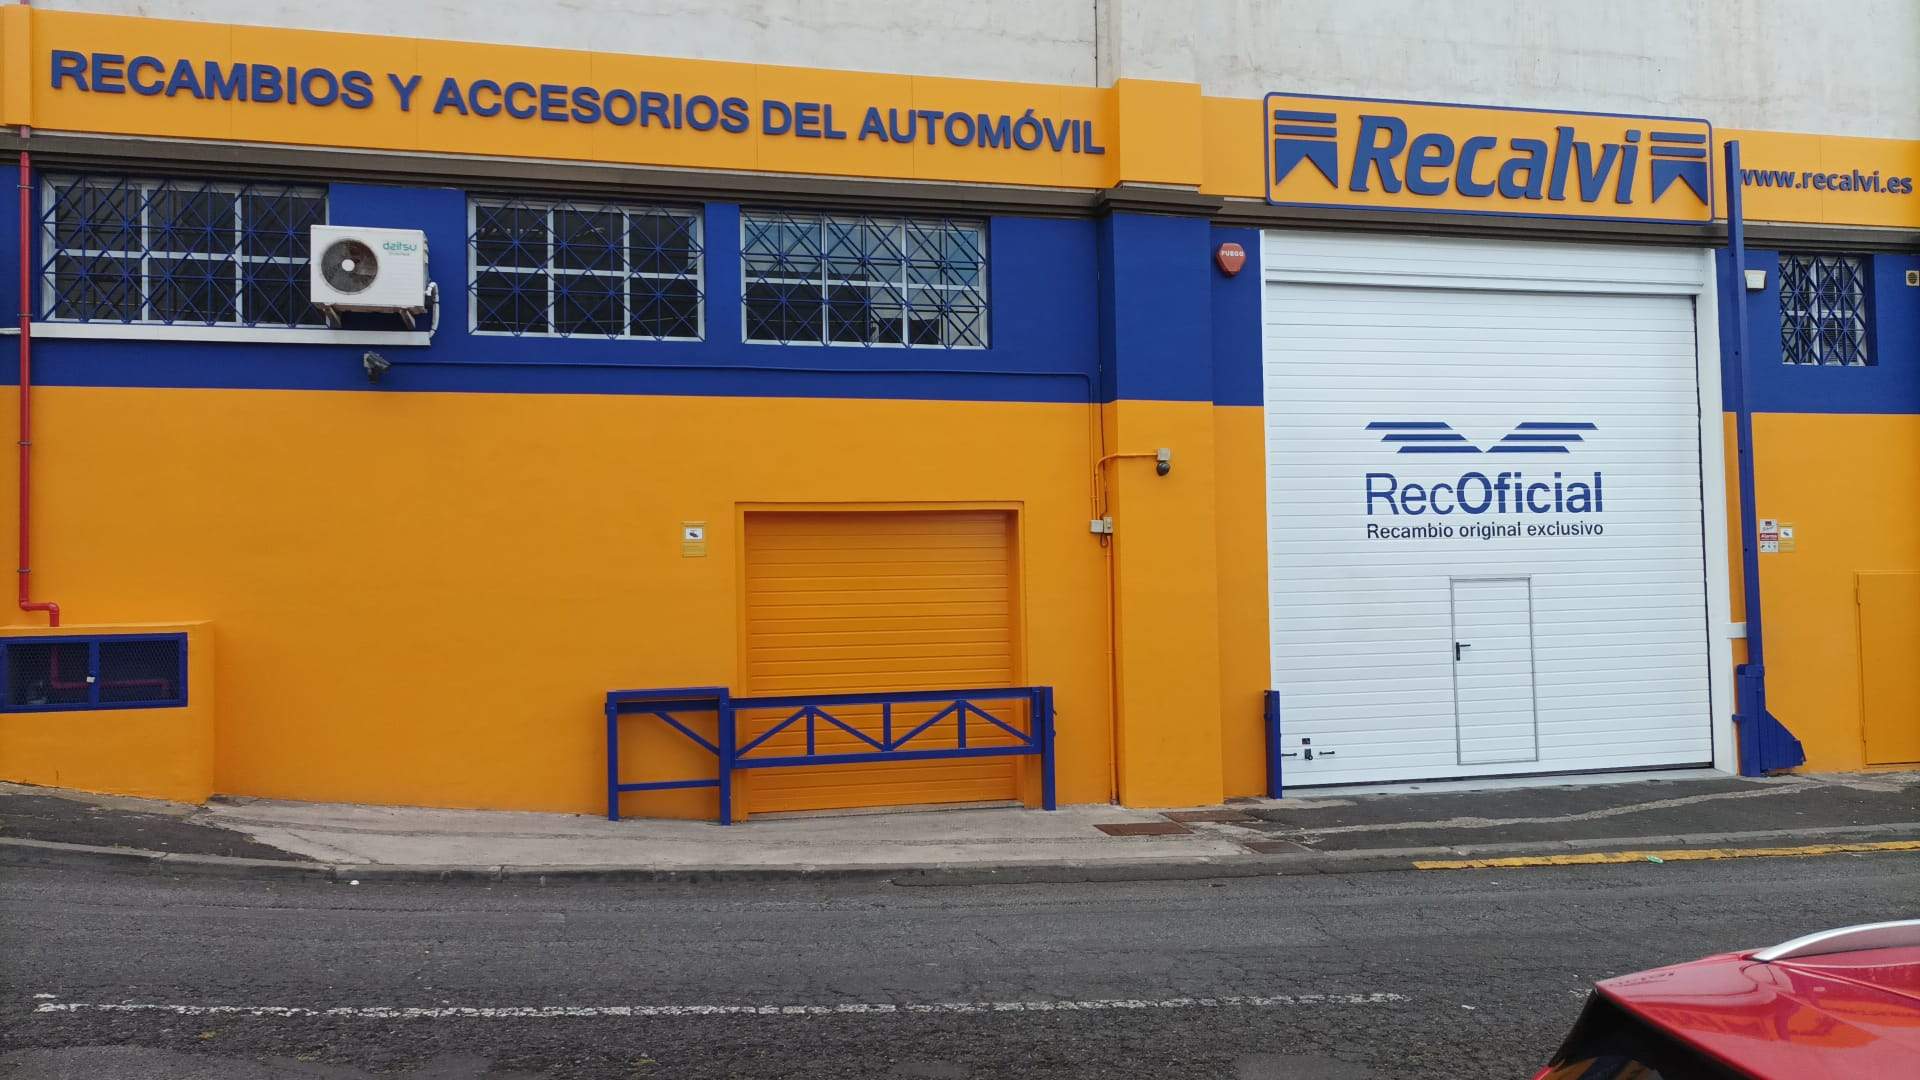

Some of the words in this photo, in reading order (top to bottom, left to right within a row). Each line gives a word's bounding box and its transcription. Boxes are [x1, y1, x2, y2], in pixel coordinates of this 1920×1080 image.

[51, 50, 373, 109] RECAMBIOS
[388, 74, 422, 112] Y
[433, 78, 750, 134] ACCESORIOS
[763, 100, 847, 140] DEL
[858, 108, 1106, 155] AUTOMÓVIL
[1348, 114, 1642, 204] Recalvi
[1740, 169, 1913, 194] www.recalvi.es
[1366, 472, 1603, 515] RecOficial
[1366, 522, 1454, 539] Recambio
[1459, 521, 1522, 540] original
[1527, 521, 1604, 537] exclusivo
